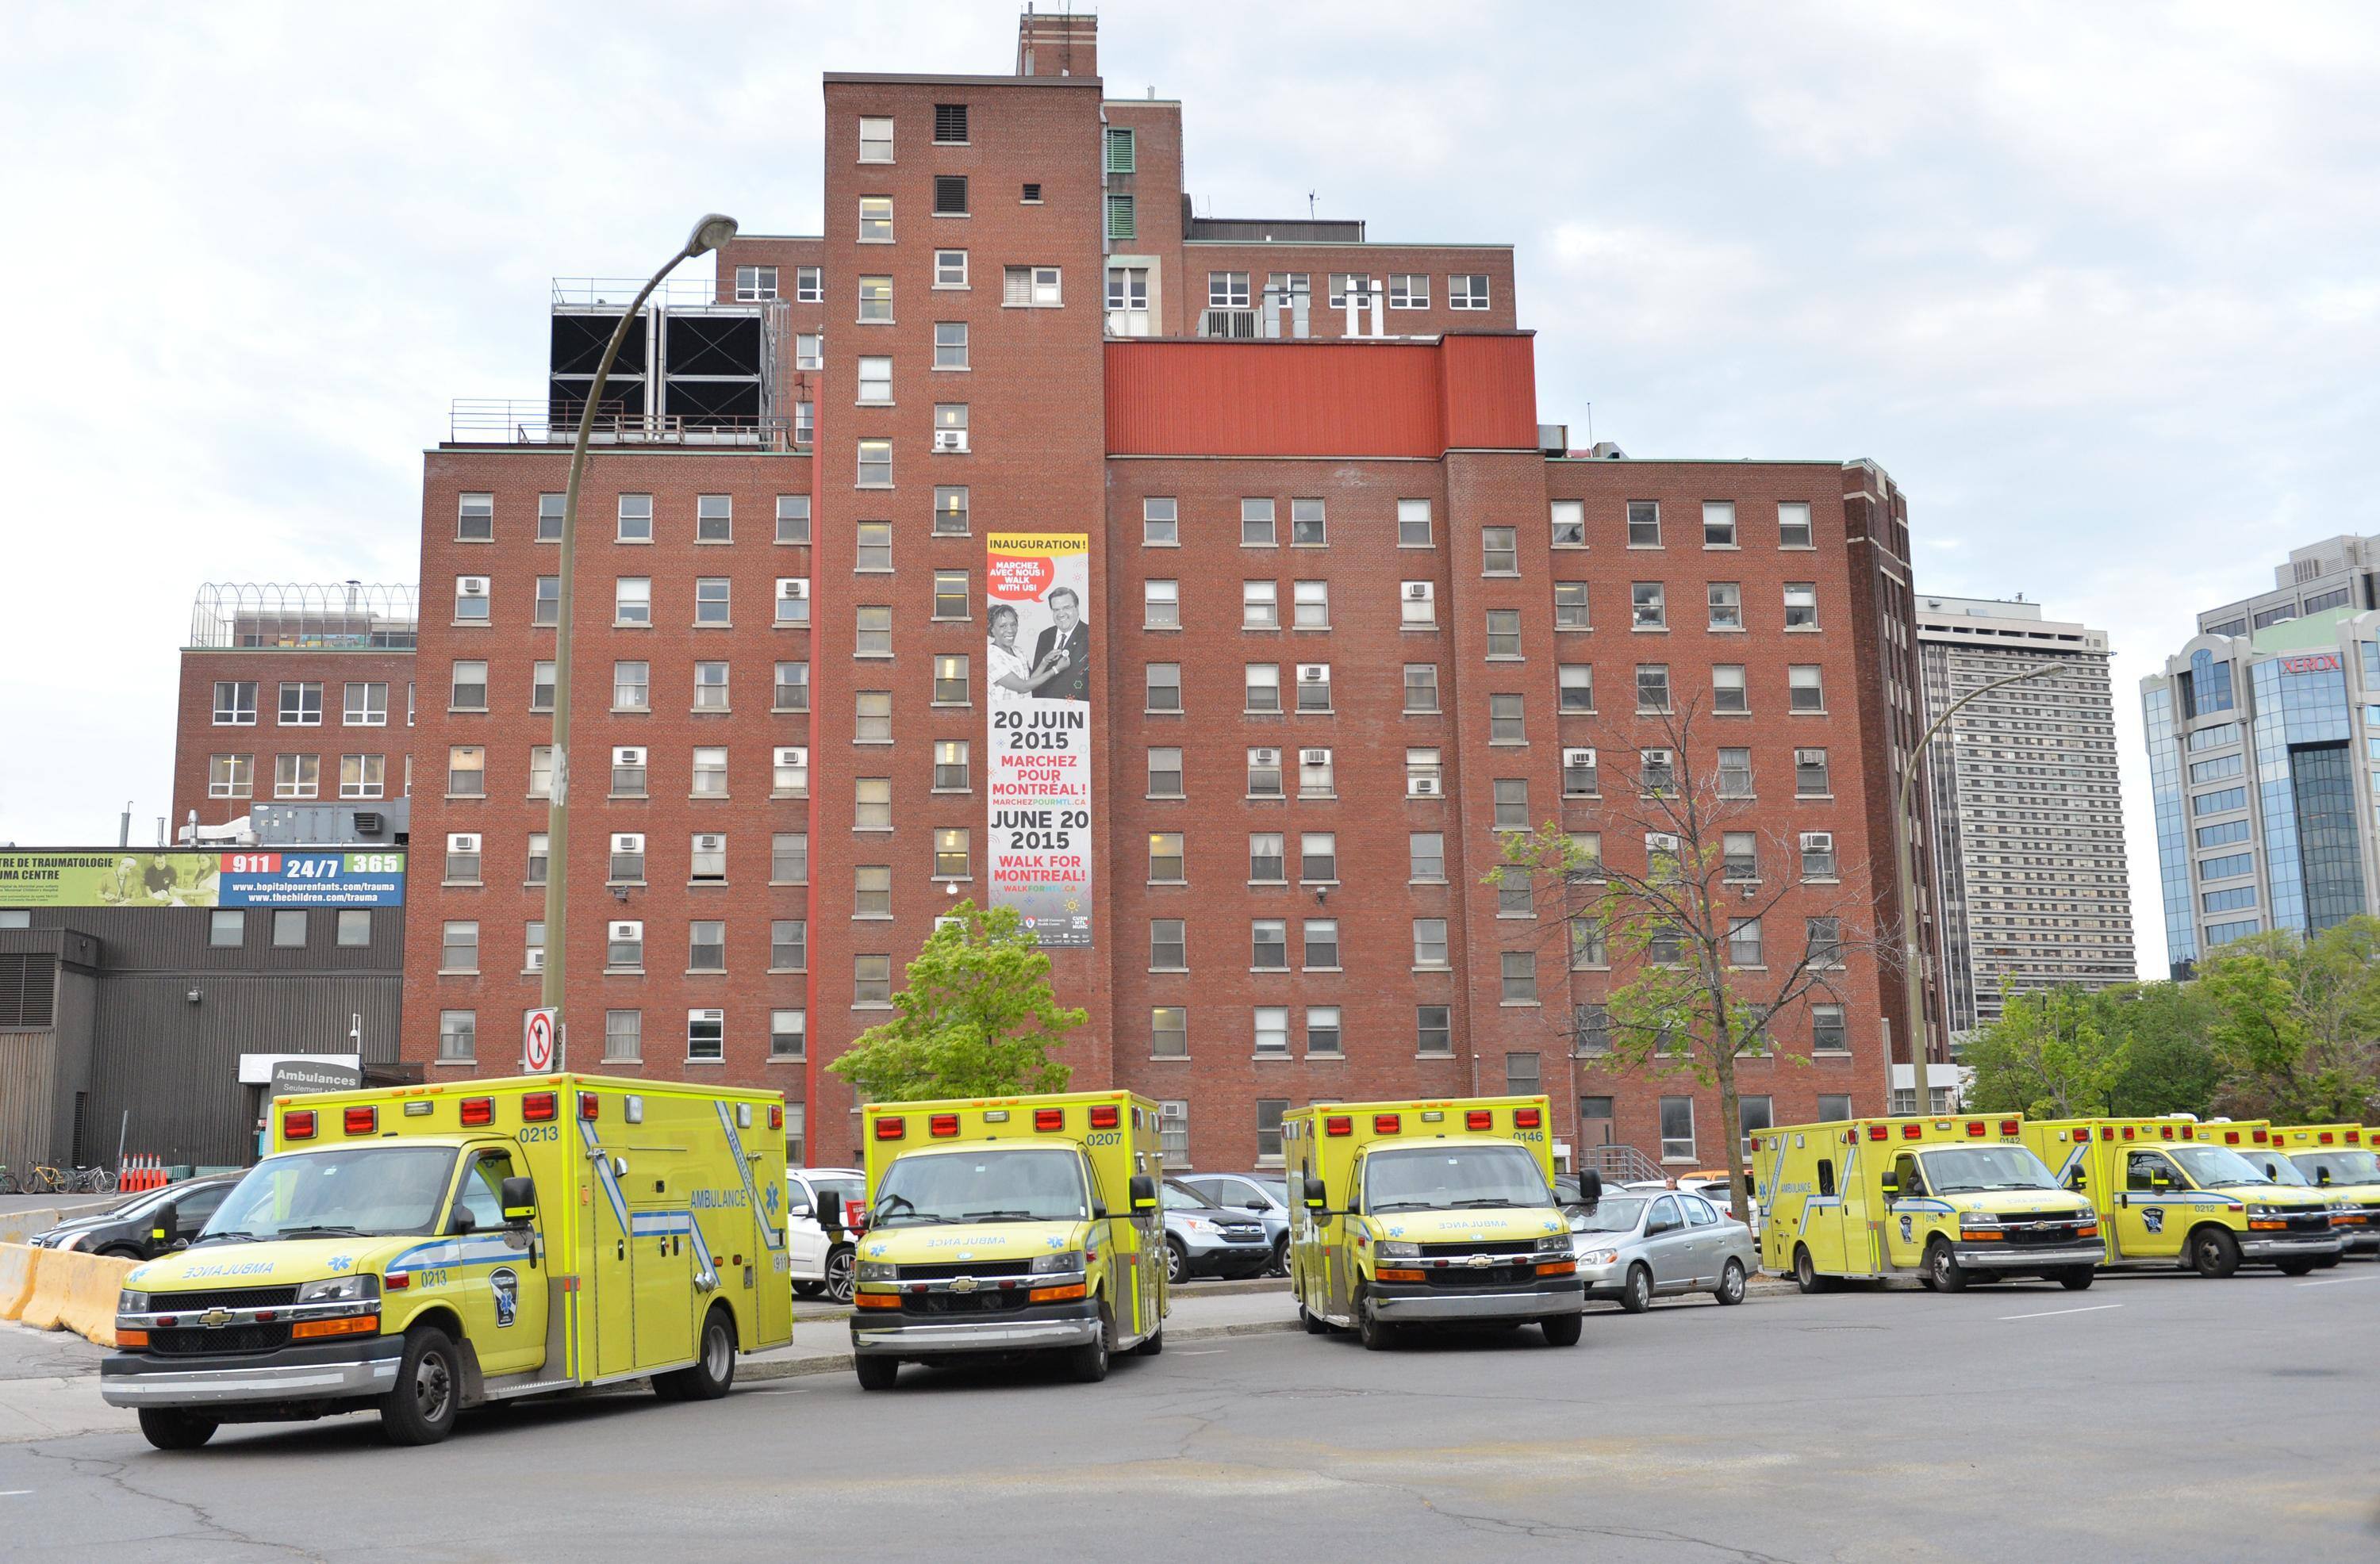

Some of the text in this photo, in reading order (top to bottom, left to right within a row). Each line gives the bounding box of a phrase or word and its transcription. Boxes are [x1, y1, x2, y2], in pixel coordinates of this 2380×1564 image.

[2282, 654, 2340, 674] XEROX
[994, 711, 1084, 729] 20 JUIN
[1010, 731, 1069, 749] 2015
[1001, 755, 1077, 767] MARCHEZ
[1017, 769, 1061, 781] POUR
[991, 811, 1089, 829] JUNE 20
[1011, 831, 1069, 849] 2015
[17, 858, 29, 868] DE
[33, 857, 113, 868] TRAUMATOLOGIE
[232, 855, 270, 872] 911
[286, 860, 339, 878] 24/7
[353, 855, 397, 872] 365
[998, 855, 1081, 868] WALK FOR
[21, 870, 60, 880] CENTRE
[994, 869, 1086, 882] MONTREAL!
[232, 882, 395, 893] www.hopitalpourenfants.com/trauma
[248, 893, 378, 903] www.thechildren.com/trauma
[276, 1069, 356, 1086] Ambulances
[283, 1083, 323, 1094] Seulement
[520, 1125, 559, 1143] 0213
[1087, 1133, 1122, 1146] 0207
[1513, 1131, 1543, 1142] 0146
[728, 1130, 753, 1190] PARAMEDIC
[1781, 1182, 1812, 1194] AMBULANCE
[690, 1190, 747, 1209] AMBULANCE
[421, 1269, 447, 1288] 0213
